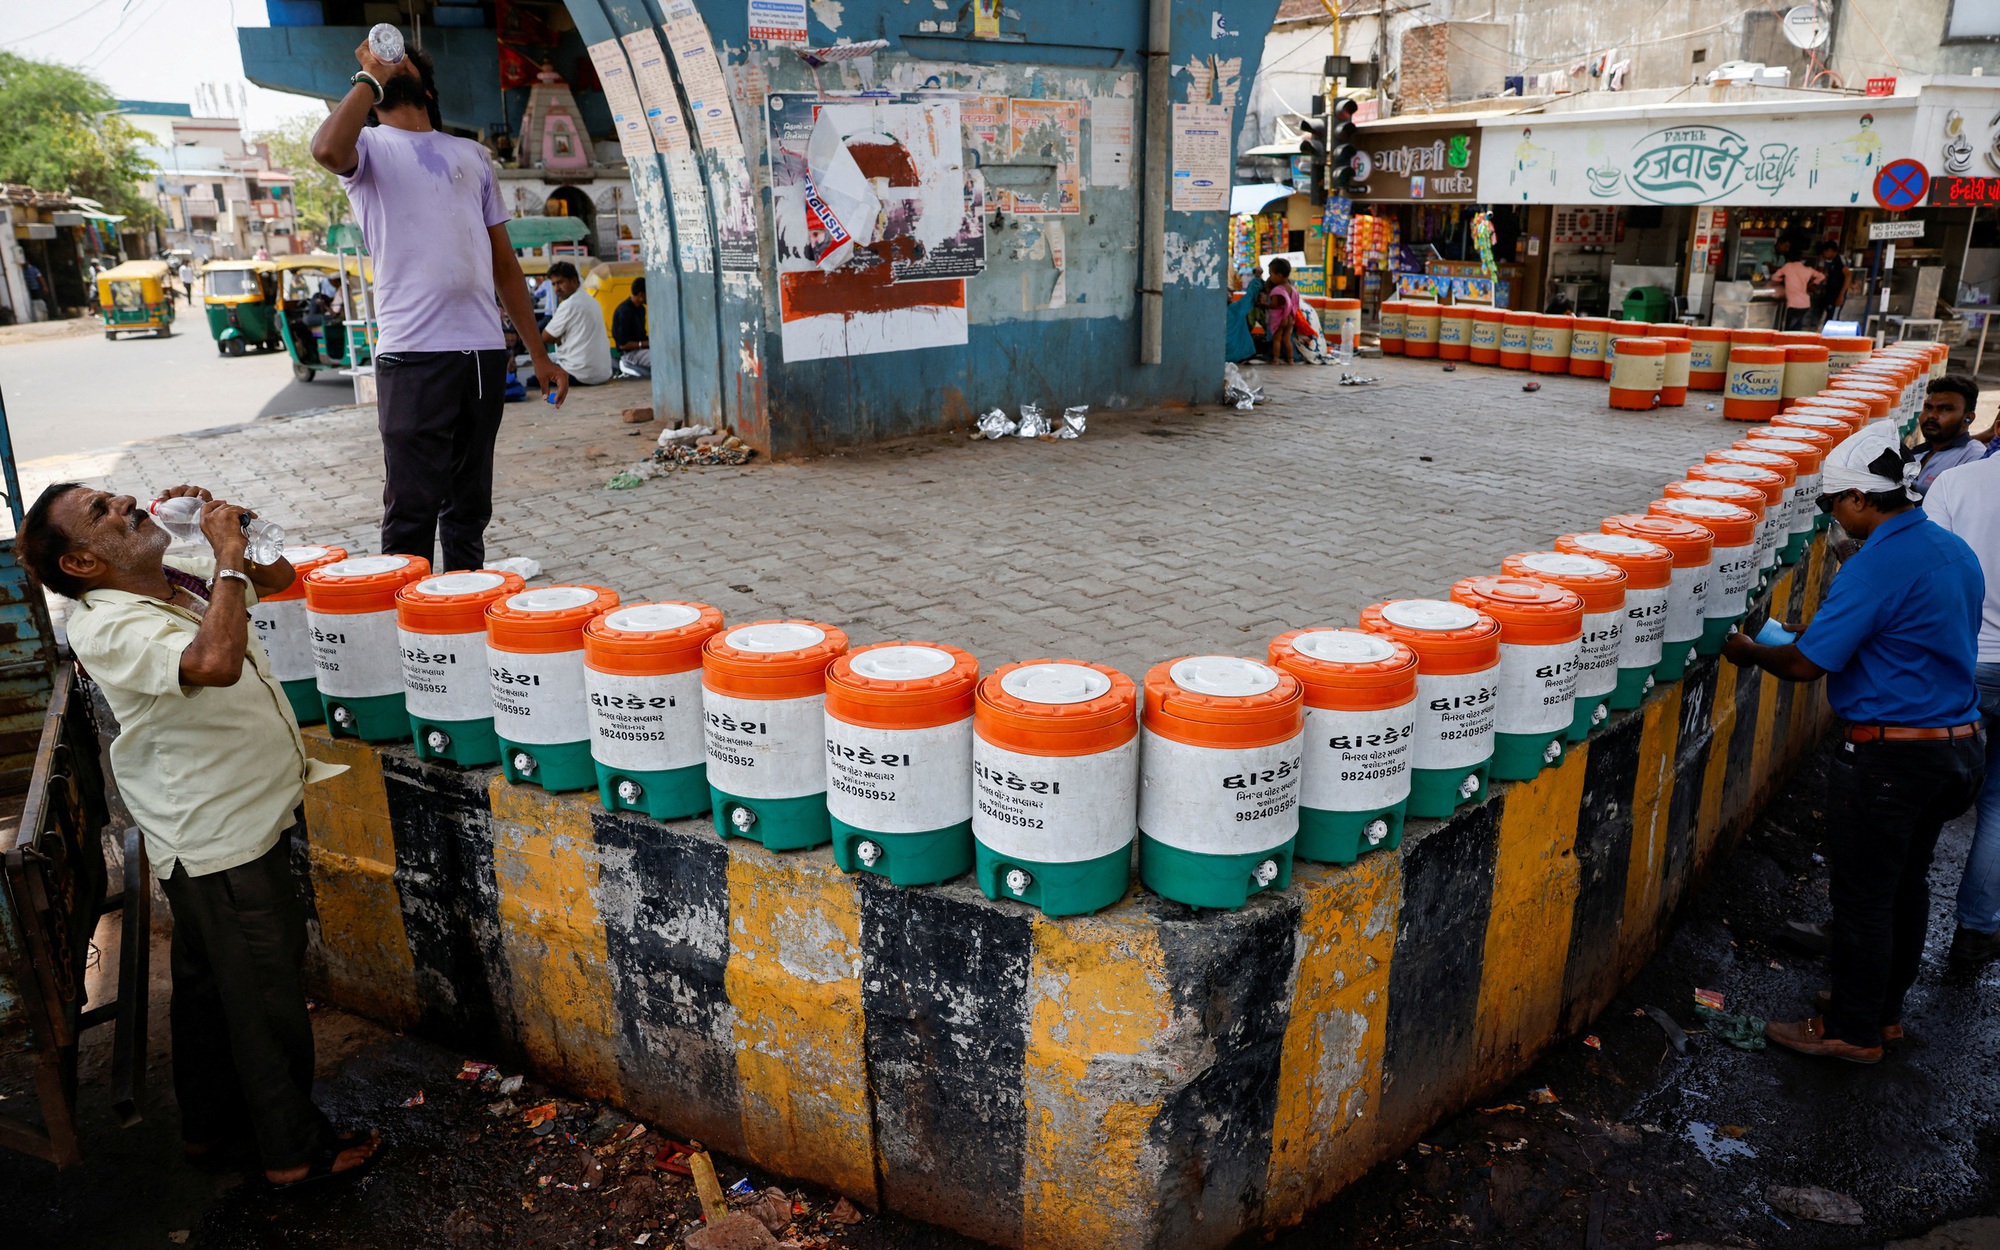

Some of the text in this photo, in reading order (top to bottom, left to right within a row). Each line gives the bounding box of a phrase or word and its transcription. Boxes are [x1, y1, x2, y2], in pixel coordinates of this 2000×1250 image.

[784, 131, 810, 140] સિનેમાઘ
[1664, 130, 1706, 142] PATEL
[805, 174, 846, 241] ENGLISH
[1884, 230, 1920, 238] STANDING
[1885, 222, 1921, 231] STOPPING
[308, 627, 346, 644] રકેશ
[1536, 654, 1579, 678] દ્વારકે
[488, 667, 540, 686] ારકેશ
[492, 698, 531, 716] 24095952
[590, 693, 676, 710] દ્વારકેશ
[616, 712, 632, 723] વોટર
[633, 714, 663, 723] સપ્લાયર
[600, 726, 666, 742] 9824095952
[1329, 722, 1414, 749] દ્વારકેશ
[706, 743, 755, 768] 24095952
[826, 739, 910, 768] દ્વારકેશ
[1342, 751, 1368, 762] મિનરલ
[1369, 749, 1387, 760] વોટર
[974, 760, 1060, 795] દ્વારકેશ
[1341, 761, 1406, 781] 9824095952
[832, 777, 896, 802] 9824095952
[978, 799, 1044, 830] 9824095952
[1236, 794, 1297, 822] 9824095952
